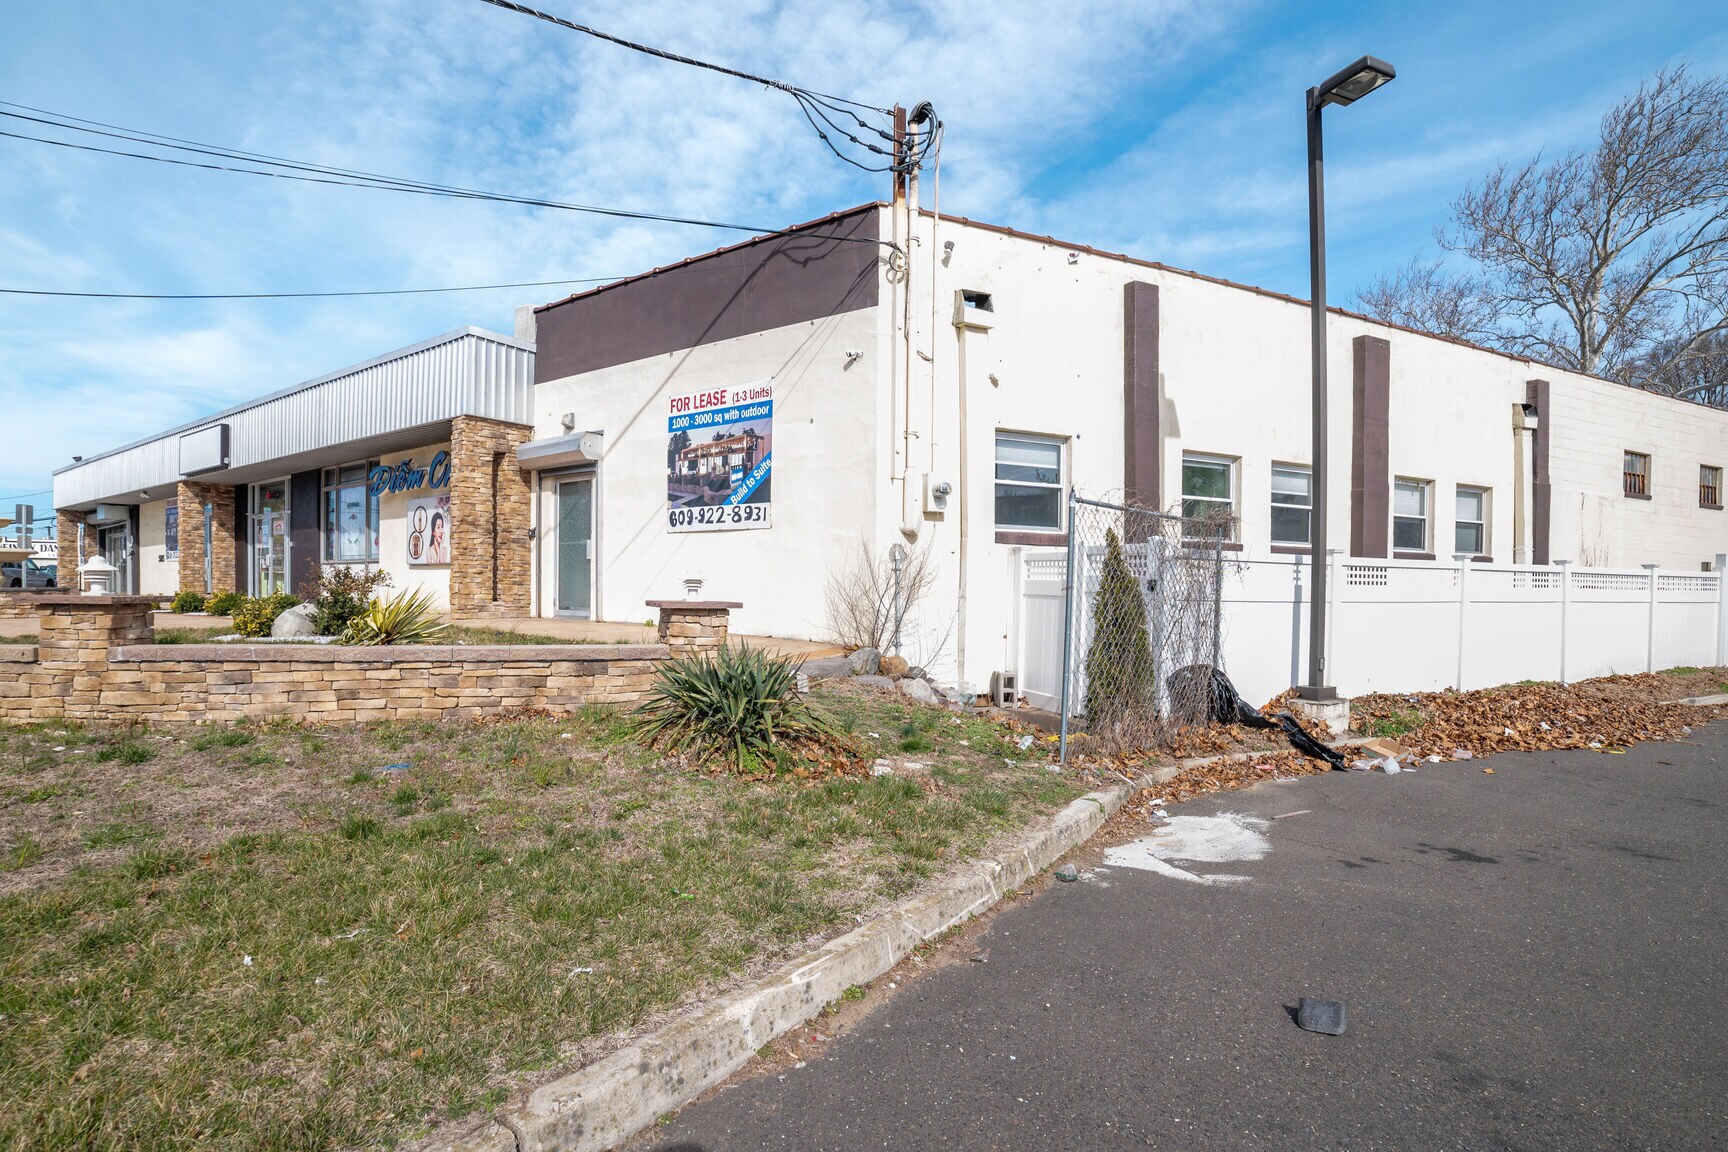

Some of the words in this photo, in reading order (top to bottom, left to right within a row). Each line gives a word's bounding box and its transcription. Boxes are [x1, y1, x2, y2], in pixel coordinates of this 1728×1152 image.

[670, 396, 690, 413] FOR
[693, 389, 727, 409] LEASE
[732, 390, 747, 405] (1-3
[749, 386, 773, 400] Units)
[672, 416, 689, 429] 1000
[694, 412, 713, 425] 3000
[713, 413, 723, 422] sq
[723, 408, 740, 421] with
[741, 405, 770, 418] outdoor
[730, 484, 749, 505] Build
[746, 477, 756, 488] to
[753, 459, 772, 480] Suite
[669, 505, 767, 528] 609-922-8931
